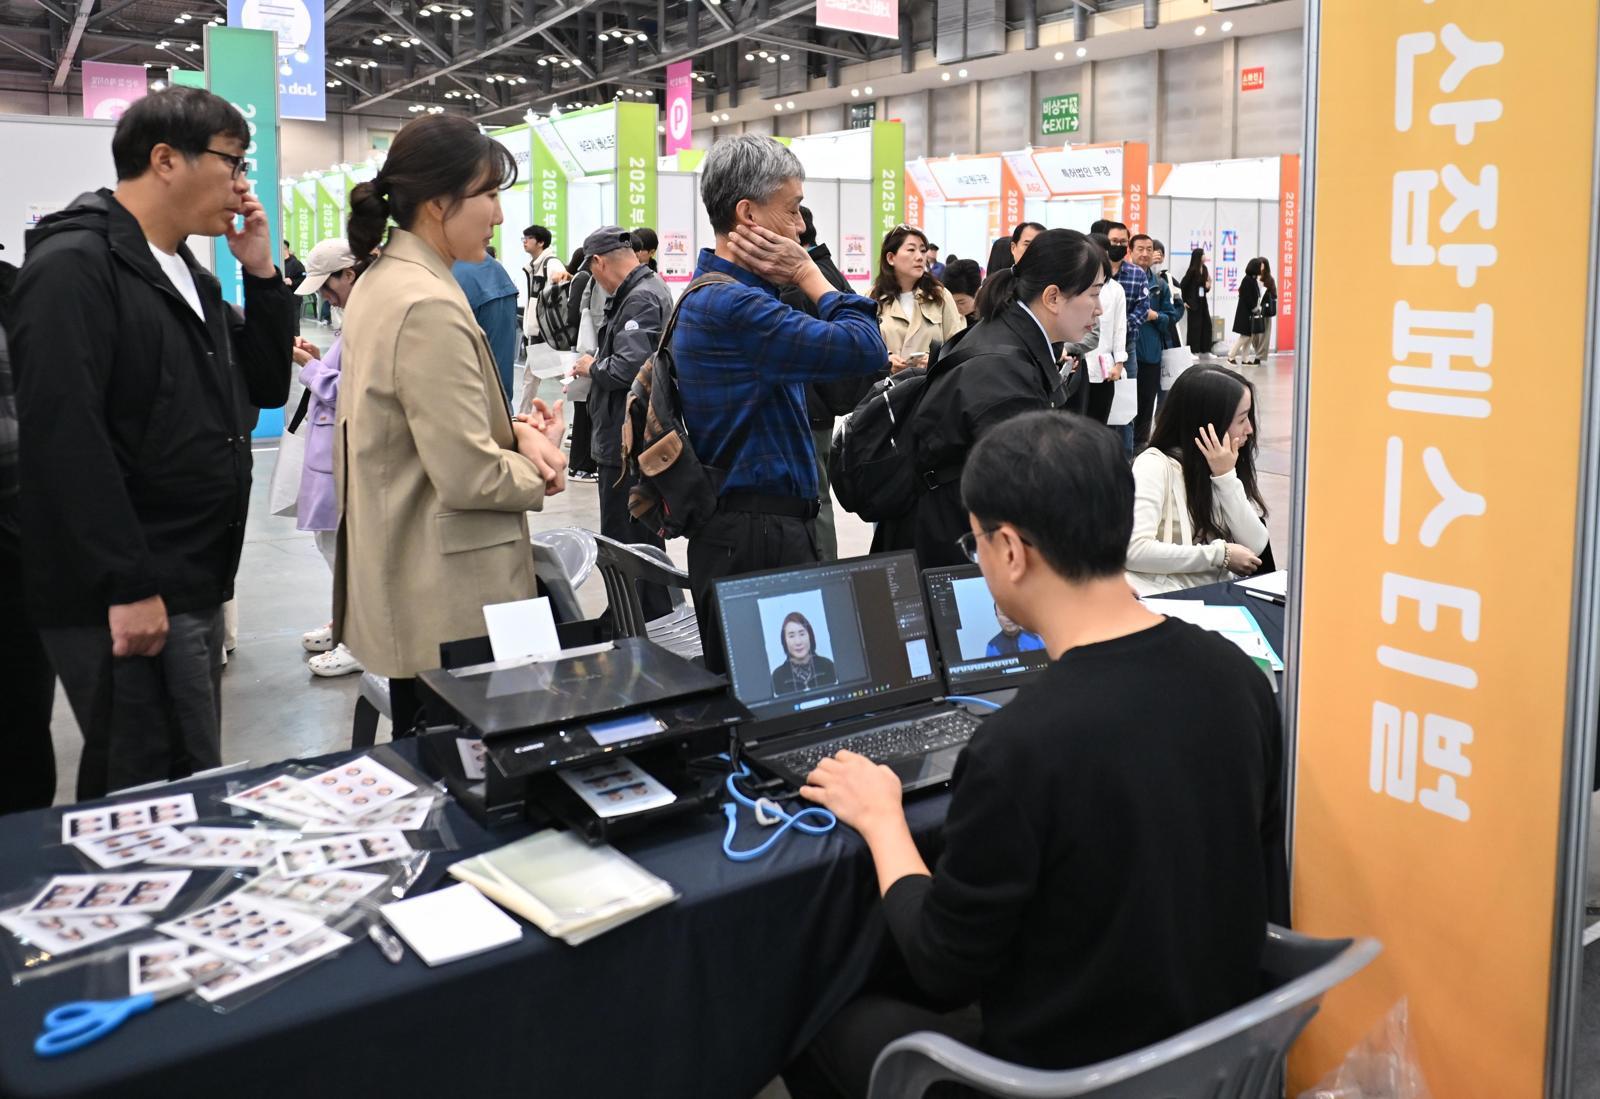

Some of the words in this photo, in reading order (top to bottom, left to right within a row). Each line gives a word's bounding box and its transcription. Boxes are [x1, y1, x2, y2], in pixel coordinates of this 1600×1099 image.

[1043, 98, 1069, 116] 비상구
[1049, 117, 1071, 131] EXIT
[543, 170, 557, 210] 2025
[629, 157, 645, 205] 2025
[882, 169, 896, 212] 2025
[323, 204, 333, 227] 2025
[909, 195, 918, 225] 2025
[1008, 190, 1018, 222] 2025
[1130, 183, 1141, 221] 2025
[1285, 192, 1294, 225] 2025
[299, 208, 308, 230] 2025
[1216, 267, 1240, 292] 티벌
[1369, 0, 1505, 821] 산잡페스티벌
